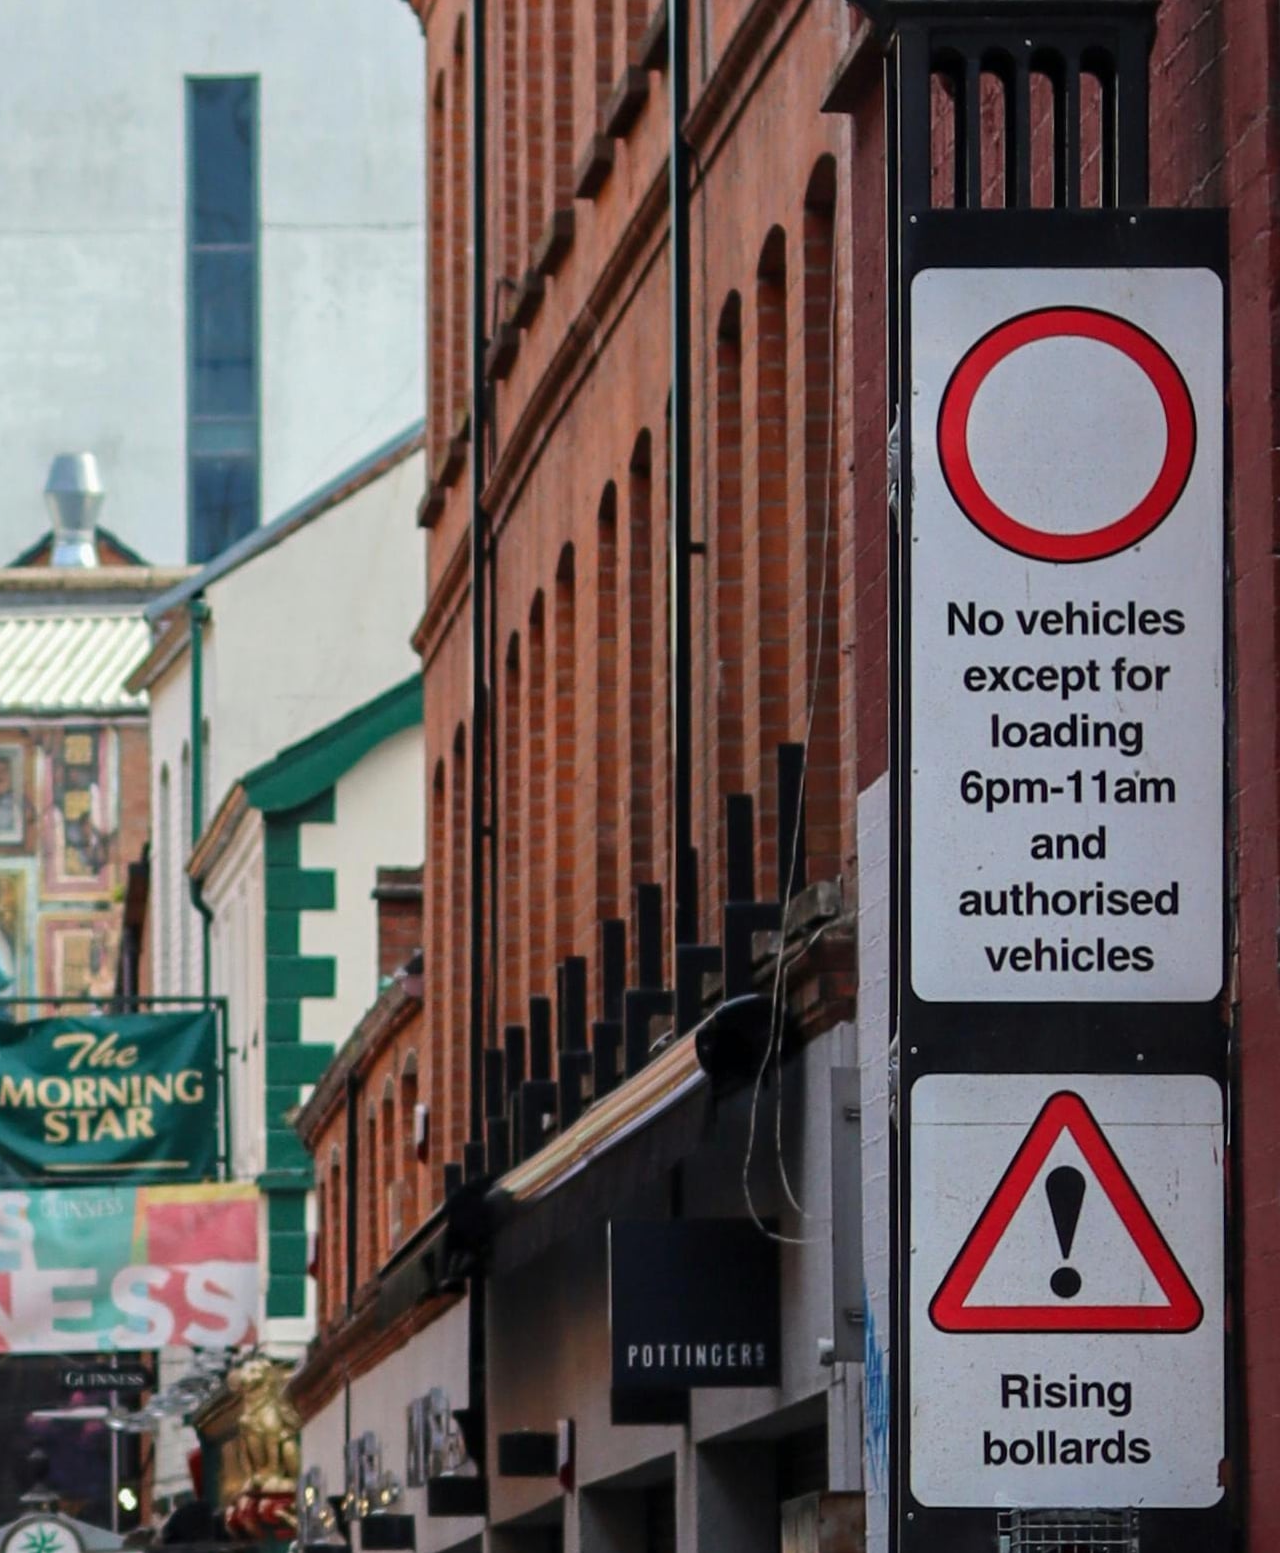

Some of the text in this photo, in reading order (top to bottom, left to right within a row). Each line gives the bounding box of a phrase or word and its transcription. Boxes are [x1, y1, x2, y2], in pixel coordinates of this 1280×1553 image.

[947, 601, 1186, 636] No vehicles
[963, 656, 1171, 701] except for
[991, 713, 1143, 757] loading
[960, 769, 1176, 813] 6pm-11am
[1030, 825, 1106, 860] and
[959, 881, 1179, 917] authorised
[984, 937, 1155, 972] vehicles
[53, 1031, 138, 1070] The
[43, 1108, 157, 1143] STAR
[627, 1343, 766, 1368] POTTINGERS
[65, 1372, 145, 1386] GUINNESS
[1001, 1373, 1132, 1418] Rising
[983, 1429, 1152, 1466] bollards
